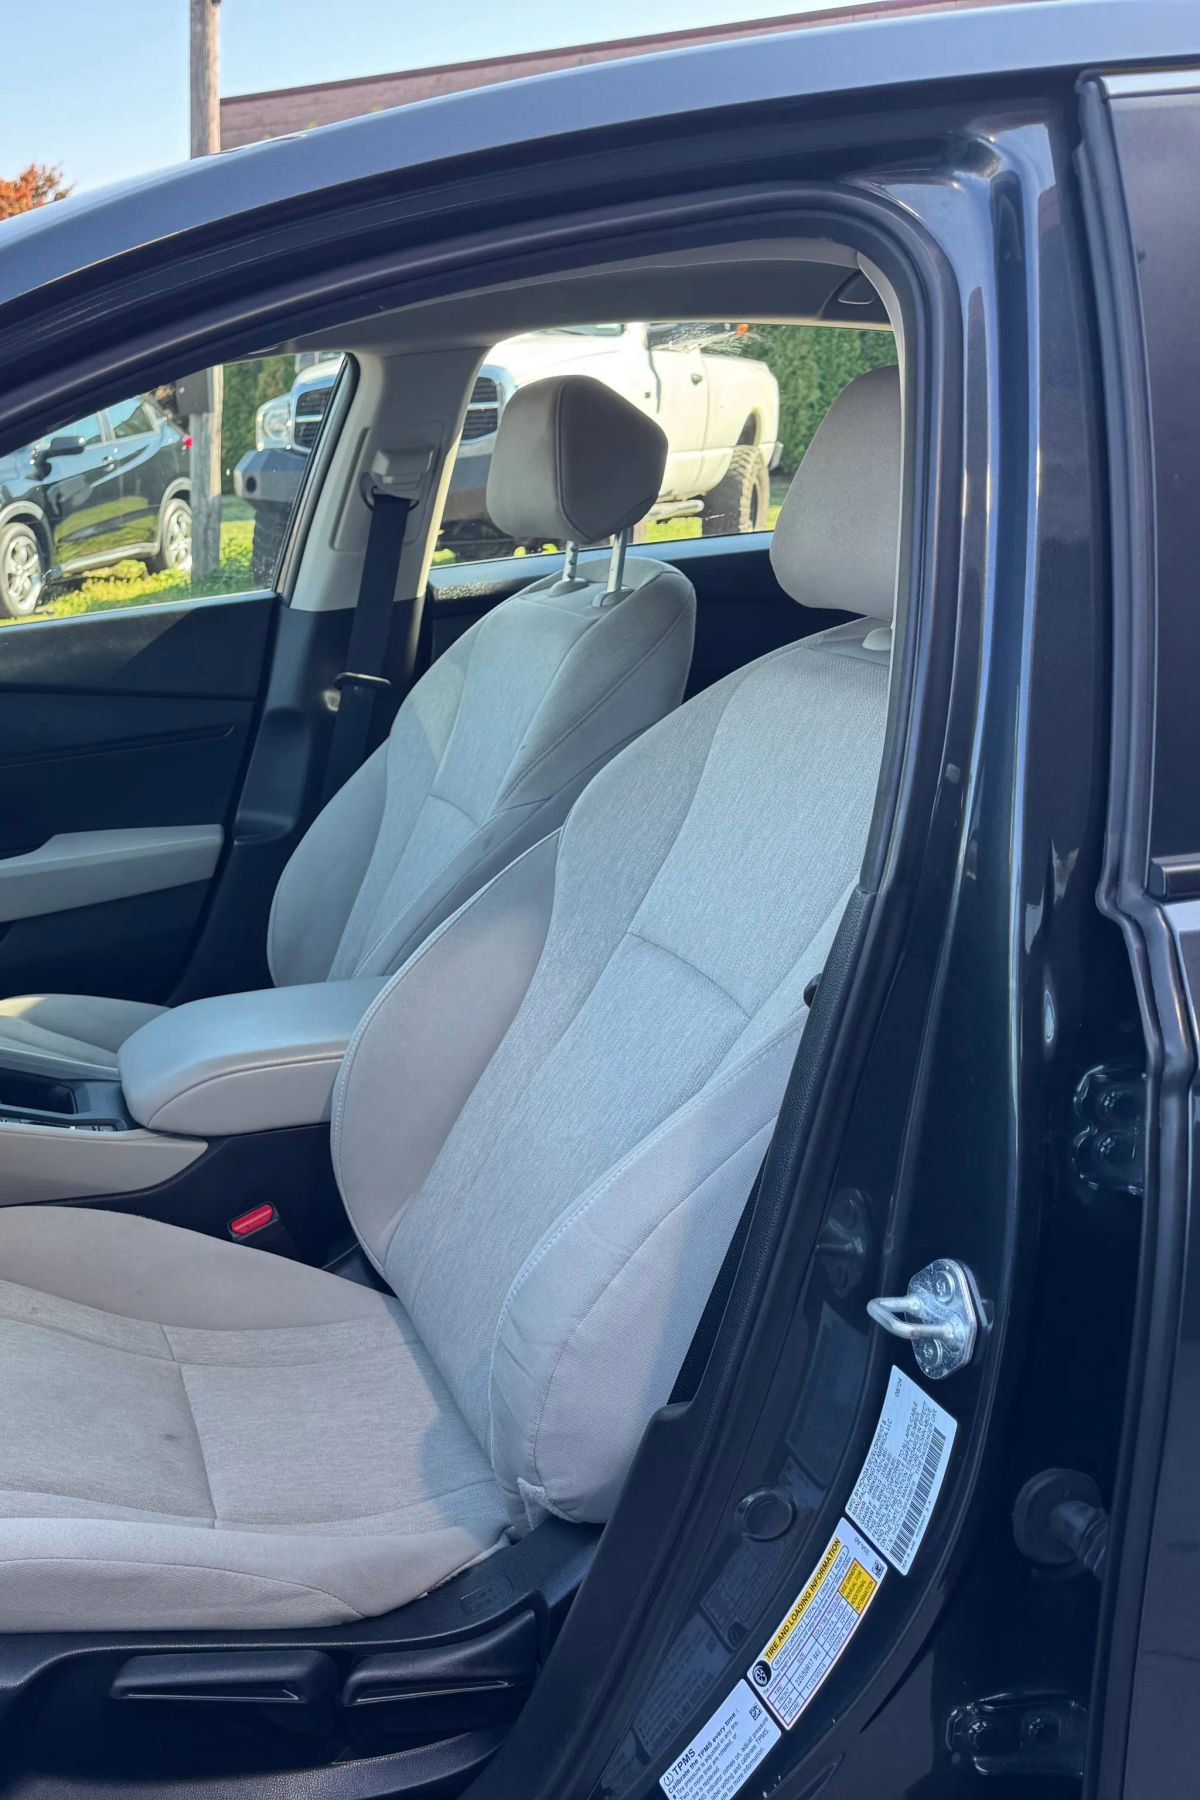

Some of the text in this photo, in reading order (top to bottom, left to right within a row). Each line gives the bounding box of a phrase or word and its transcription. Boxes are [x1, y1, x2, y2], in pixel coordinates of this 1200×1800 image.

[857, 1465, 869, 1489] HONDA
[866, 1423, 884, 1468] DEVELOPMENT
[875, 1527, 884, 1543] AND
[881, 1508, 892, 1529] THEFT
[890, 1468, 908, 1510] PREVENTION
[904, 1431, 920, 1472] STANDARDS
[918, 1399, 928, 1427] EFFECT
[851, 1465, 875, 1516] MANUFACTURING
[871, 1510, 886, 1539] FEDERAL
[883, 1486, 895, 1512] MOTOR
[892, 1460, 905, 1489] VEHICLE
[874, 1492, 887, 1520] VEHICLE
[885, 1456, 901, 1494] CONFORMS
[879, 1536, 887, 1548] ON
[884, 1523, 892, 1538] THE
[889, 1506, 899, 1526] DATE
[900, 1452, 919, 1500] MANUFACTURE
[916, 1427, 926, 1454] SHOWN
[855, 1500, 866, 1521] GVWR
[859, 1504, 870, 1525] GAWR
[863, 1509, 874, 1530] GAWR
[833, 1554, 844, 1570] REAR
[854, 1569, 862, 1581] FOR
[764, 1536, 841, 1660] TIRE AND LOADING INFORMATION
[819, 1578, 831, 1596] FRONT
[804, 1602, 816, 1620] TOTAL
[773, 1623, 804, 1668] SEATING CAPACITY
[777, 1687, 790, 1704] FRONT
[782, 1696, 793, 1712] REAR
[787, 1700, 800, 1718] SPARE
[667, 1766, 691, 1795] Calibrate
[688, 1756, 699, 1770] the
[697, 1740, 713, 1760] TPMS
[711, 1724, 726, 1744] every
[671, 1746, 696, 1777] TPMS
[675, 1783, 685, 1796] Tire
[683, 1764, 702, 1788] pressure
[703, 1741, 721, 1764] adjusted
[723, 1727, 732, 1740] any
[692, 1772, 704, 1788] more
[702, 1762, 713, 1776] tires
[710, 1754, 719, 1765] are
[705, 1772, 723, 1795] indicator
[721, 1758, 736, 1776] comes
[740, 1735, 754, 1753] adjust
[751, 1715, 769, 1739] pressure
[719, 1772, 734, 1791] setting
[732, 1763, 741, 1774] and
[739, 1742, 757, 1765] calibrate
[755, 1727, 769, 1745] TPMS
[732, 1771, 744, 1787] more
